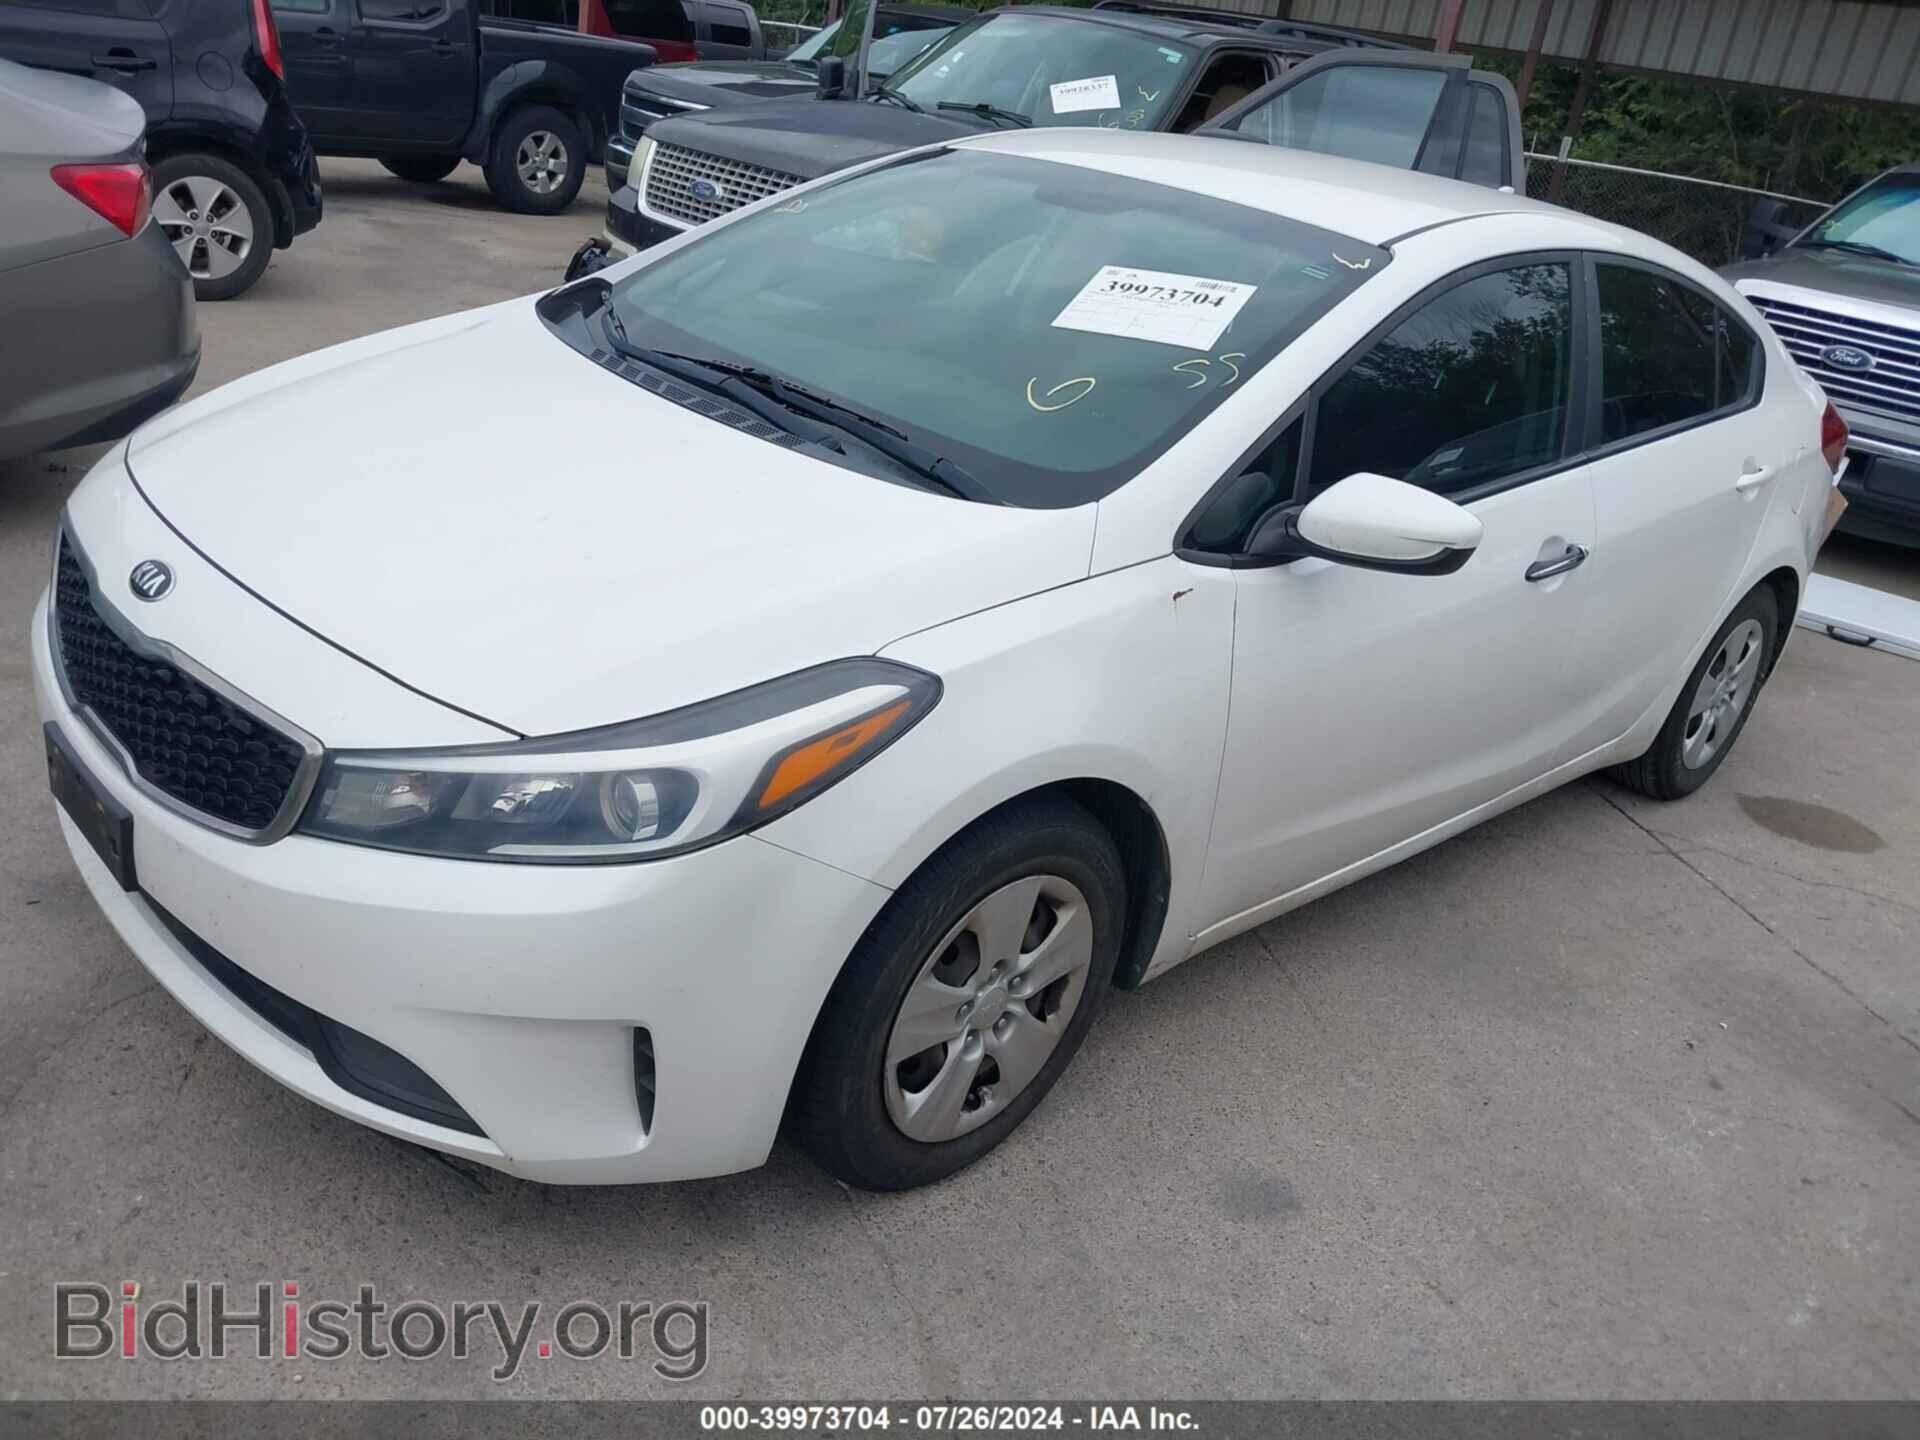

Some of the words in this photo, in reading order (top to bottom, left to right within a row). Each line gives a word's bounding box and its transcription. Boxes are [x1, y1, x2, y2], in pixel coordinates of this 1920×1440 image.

[1101, 280, 1225, 308] 39973704
[1830, 349, 1862, 365] Ford
[131, 561, 166, 596] KIA
